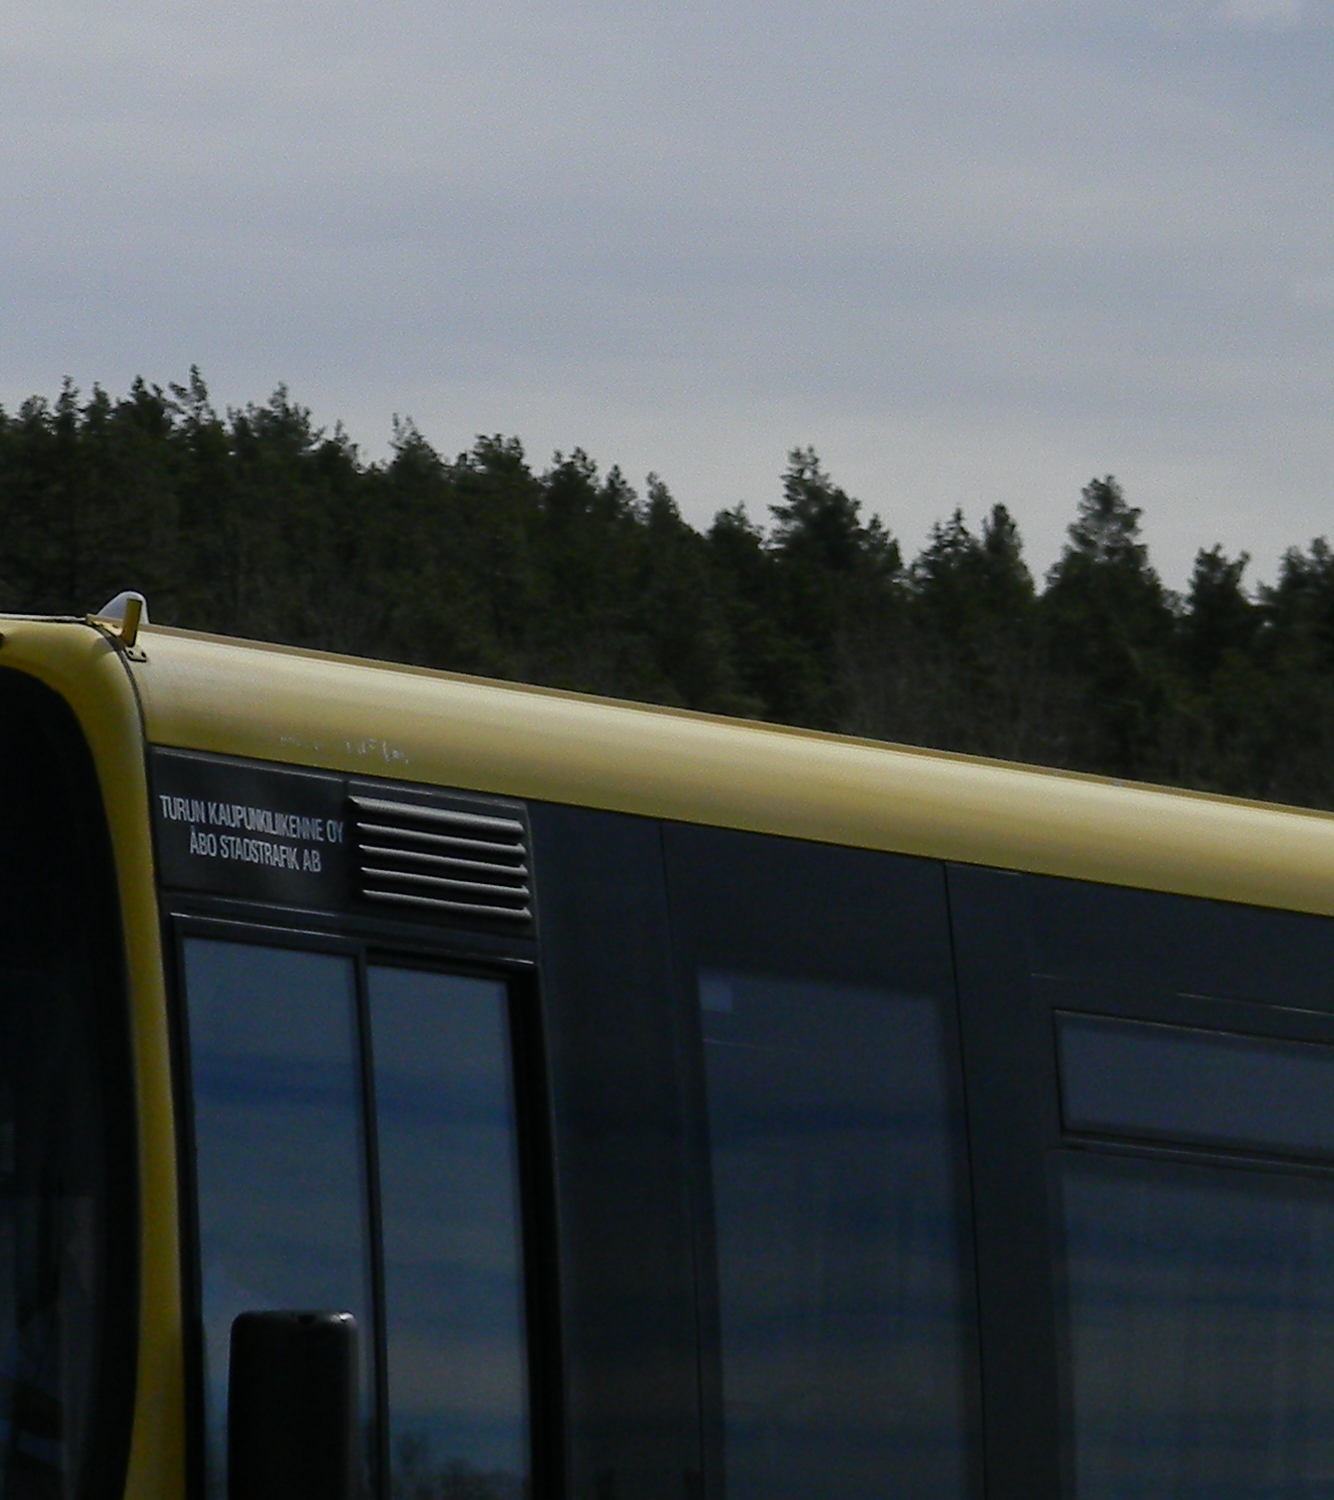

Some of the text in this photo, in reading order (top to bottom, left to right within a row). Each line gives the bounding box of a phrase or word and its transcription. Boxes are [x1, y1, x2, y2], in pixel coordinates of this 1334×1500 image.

[159, 794, 344, 844] TURUN KAUPUNKILIIKENNE OY
[189, 825, 322, 873] ÅBO STADSTRAFIK AB
